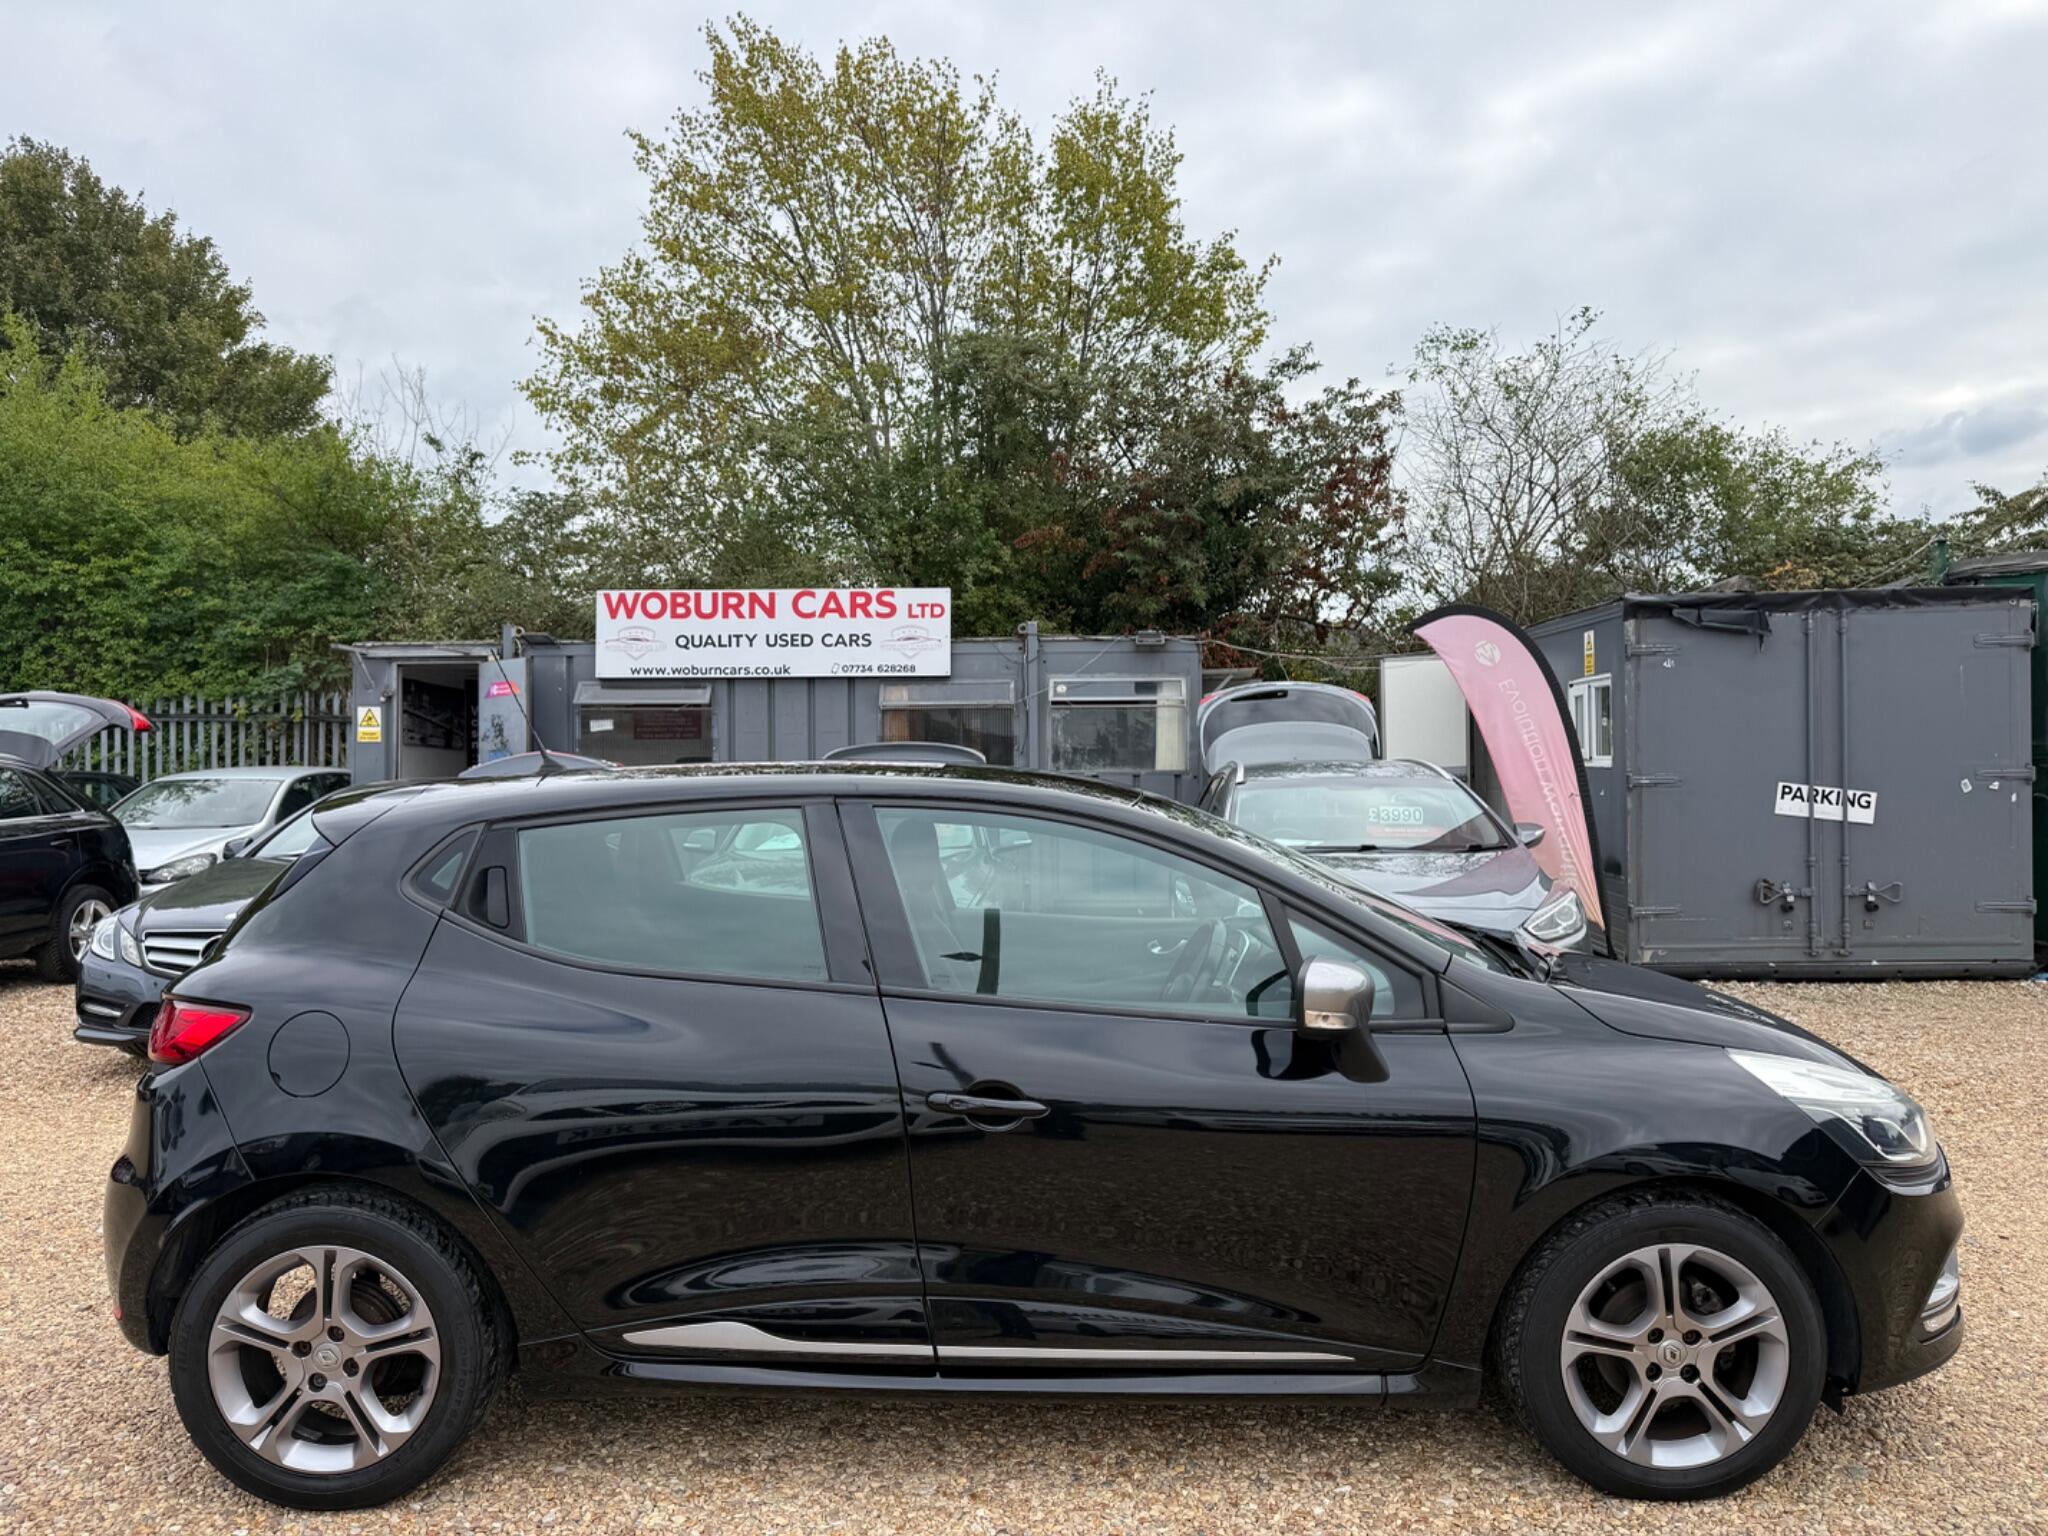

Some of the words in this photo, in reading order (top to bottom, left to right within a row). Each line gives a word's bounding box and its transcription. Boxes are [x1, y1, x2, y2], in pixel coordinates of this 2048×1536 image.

[603, 592, 776, 620] WOBURN
[791, 590, 897, 619] CARS
[907, 603, 945, 619] LTD
[674, 634, 758, 650] QUALITY
[765, 633, 814, 648] USED
[821, 633, 873, 648] CARS
[630, 663, 791, 677] www.woburncars.co.uk
[841, 664, 874, 675] 07734
[876, 663, 917, 675] 628268
[1780, 784, 1872, 810] PARKING
[1368, 807, 1423, 822] £3990
